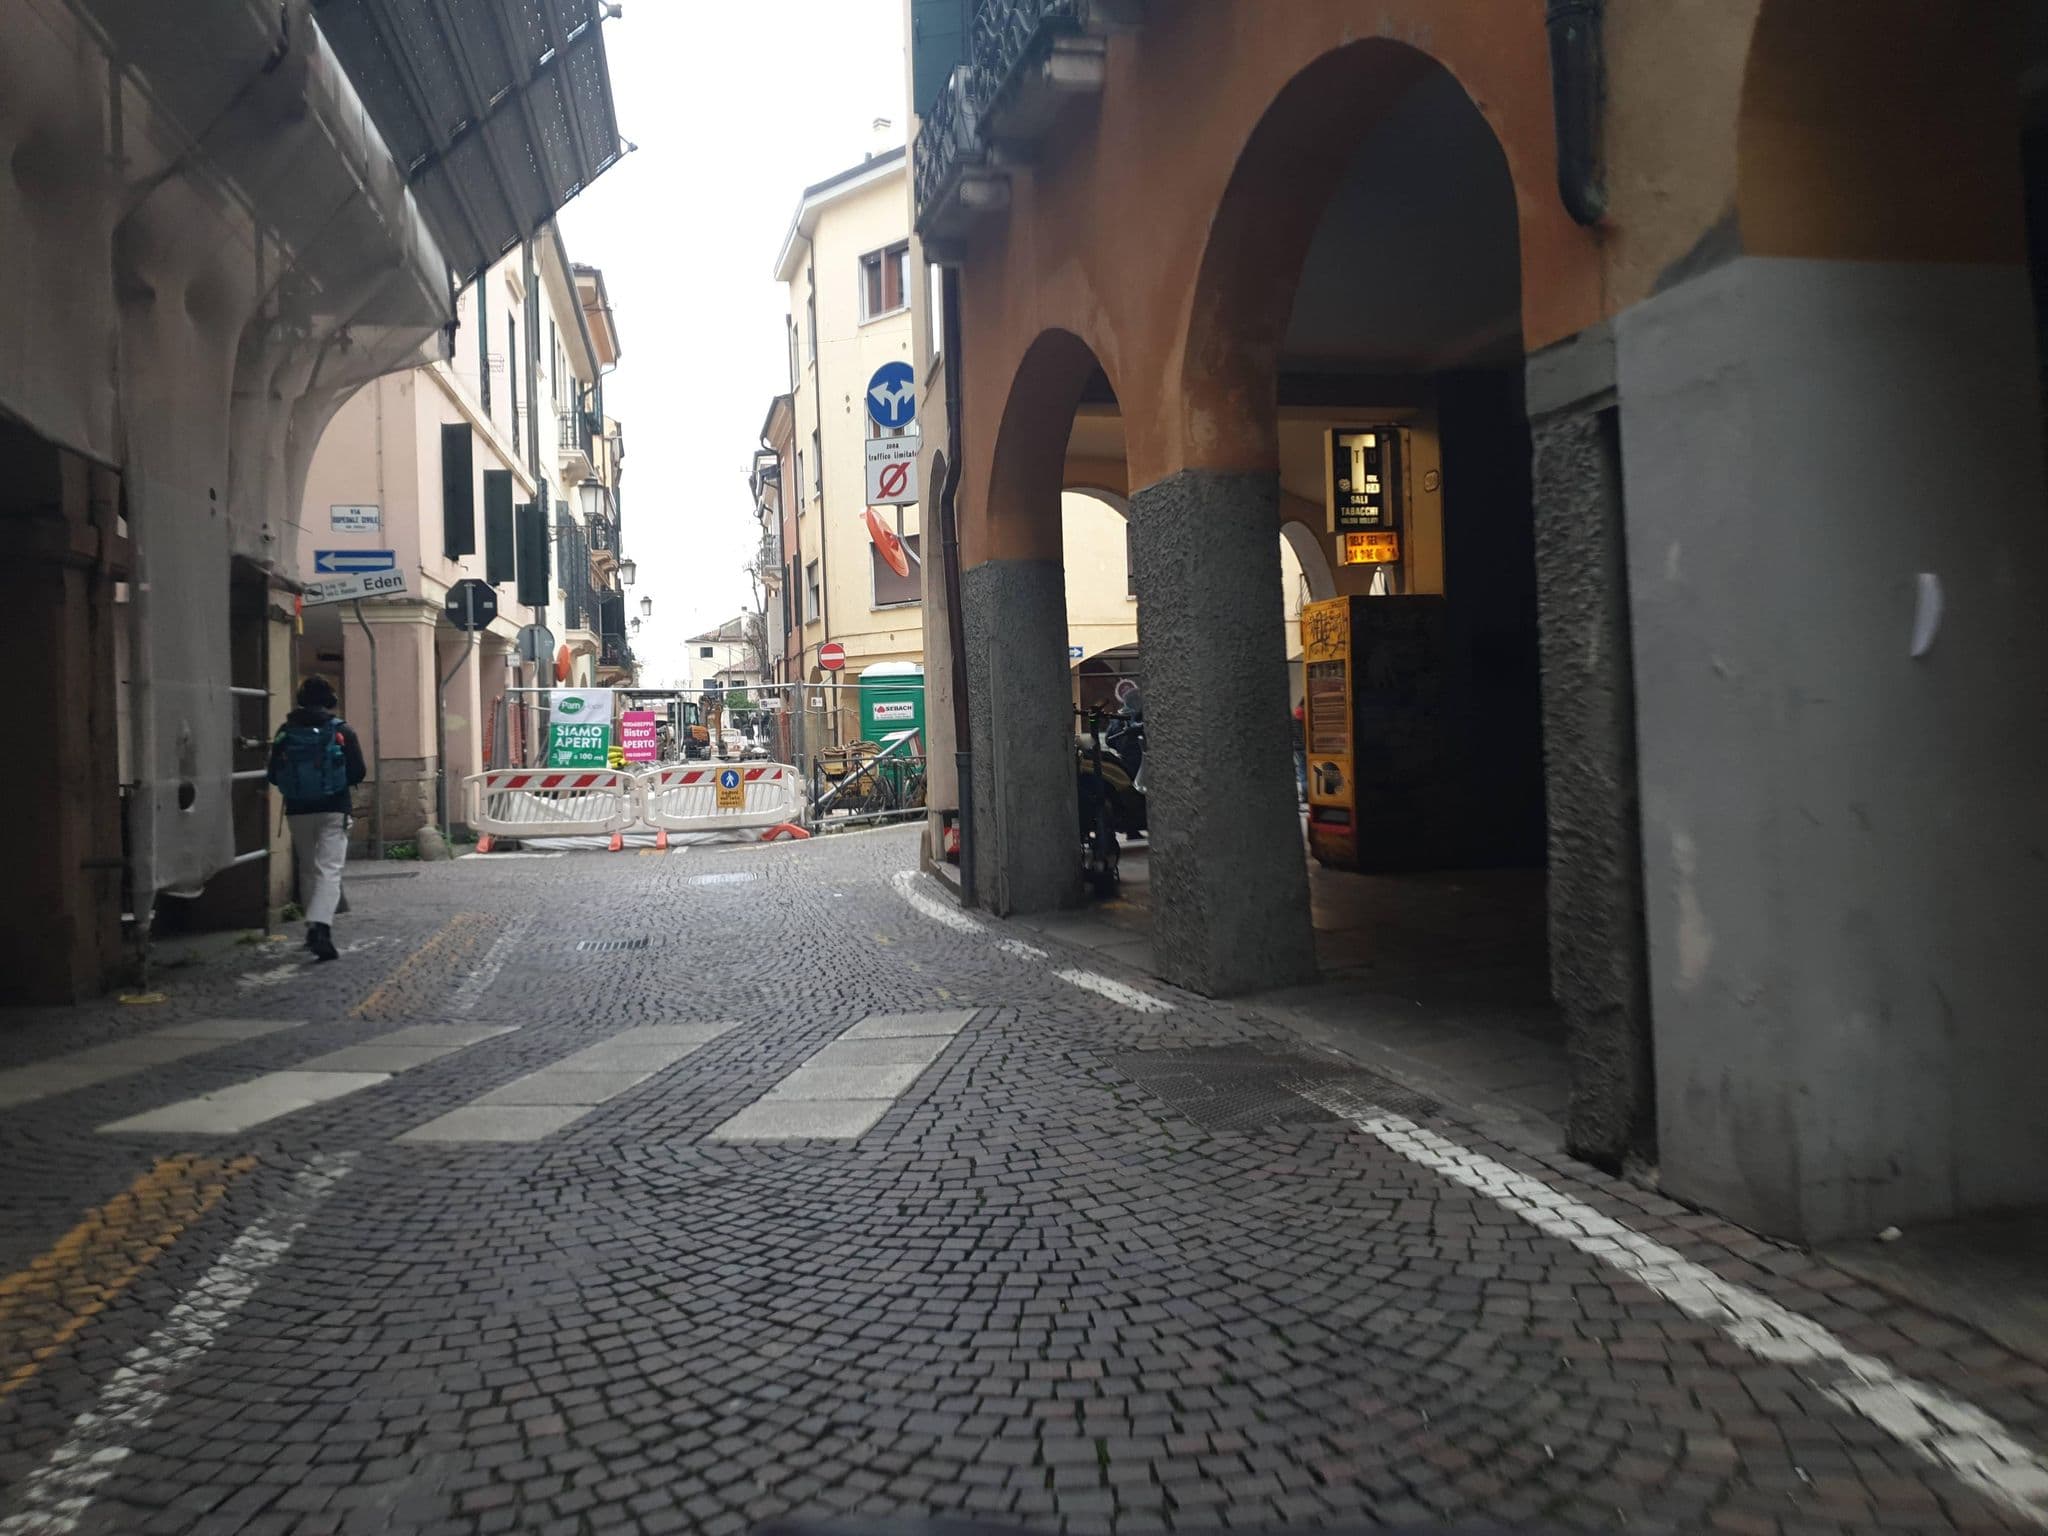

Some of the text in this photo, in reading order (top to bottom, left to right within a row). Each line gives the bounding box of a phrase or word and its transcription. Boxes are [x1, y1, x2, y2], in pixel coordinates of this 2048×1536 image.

[868, 452, 890, 461] traffico
[1350, 495, 1368, 505] SALI
[1340, 506, 1379, 516] TABACCHI
[363, 576, 403, 591] Eden
[561, 701, 581, 710] Pam
[557, 726, 602, 737] SIAMO
[555, 737, 602, 748] APERTI
[623, 740, 655, 748] APERTO
[580, 752, 593, 760] 100
